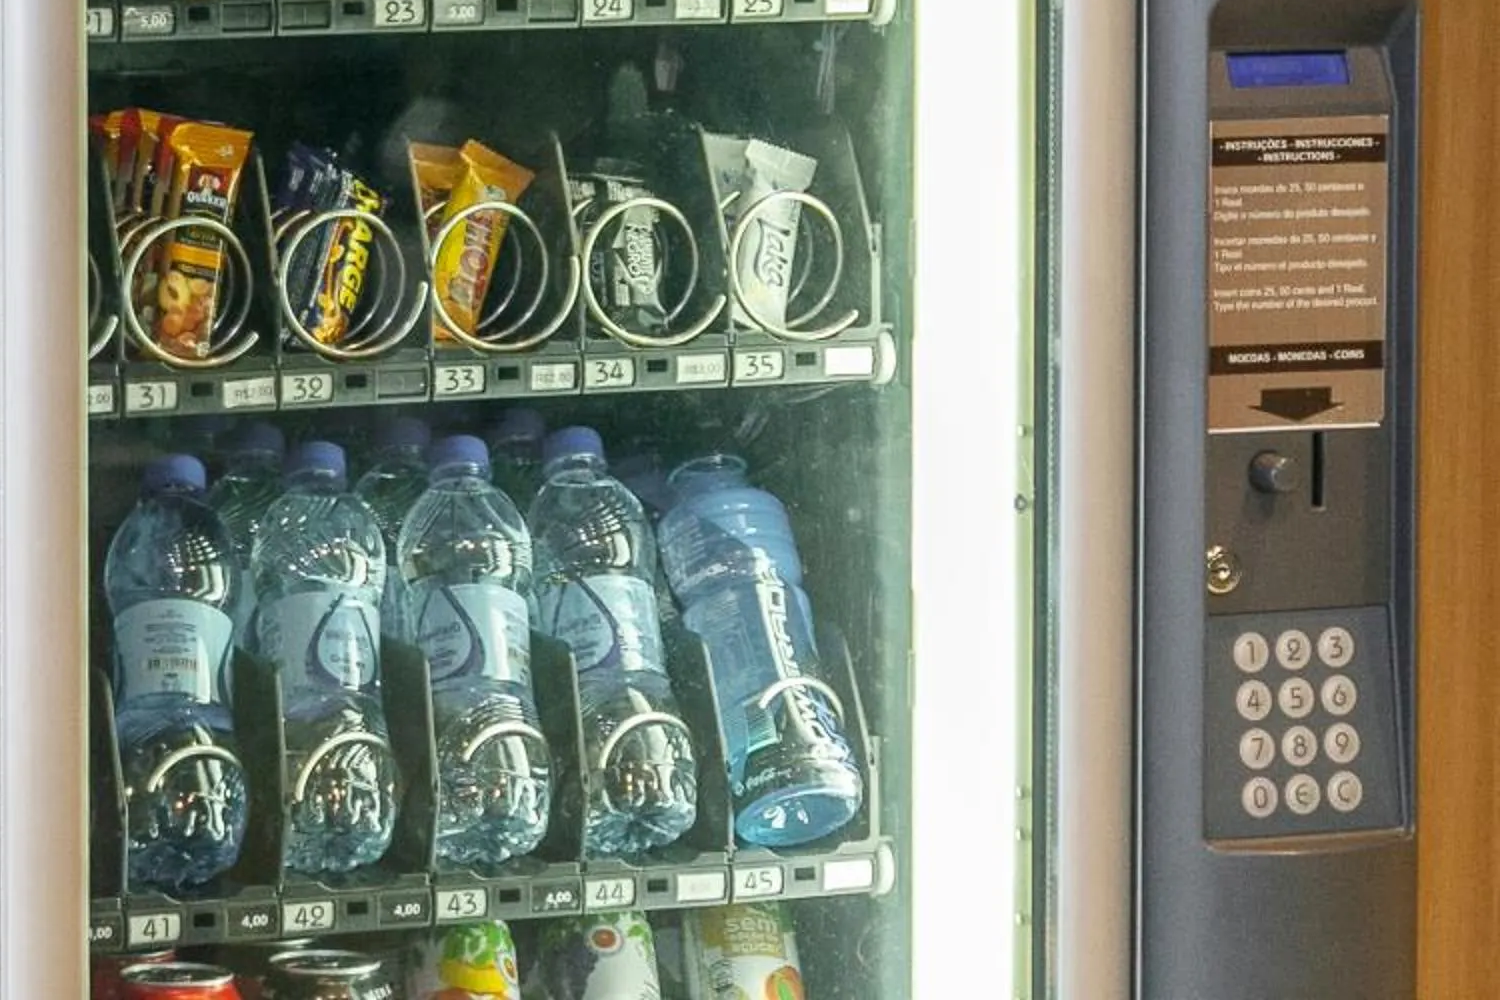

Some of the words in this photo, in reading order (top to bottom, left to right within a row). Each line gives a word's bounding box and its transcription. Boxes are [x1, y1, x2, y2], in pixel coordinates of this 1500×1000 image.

[384, 0, 415, 23] 23
[1294, 136, 1374, 149] INSTRUCCIONES
[1262, 151, 1336, 163] INSTRUCTIONS
[752, 216, 792, 290] Laka
[745, 355, 773, 377] 35
[1228, 353, 1271, 364] MOEDAS
[1277, 351, 1327, 362] MONEDAS
[1333, 349, 1365, 360] COINS
[444, 368, 475, 390] 33
[595, 359, 624, 383] 34
[139, 385, 167, 407] 31
[293, 377, 323, 399] 32
[1246, 640, 1255, 664] 1
[1286, 638, 1301, 661] 2
[1329, 635, 1343, 659] 3
[1247, 688, 1262, 712] 4
[1289, 686, 1304, 709] 5
[1332, 683, 1347, 707] 6
[1251, 737, 1264, 760] 7
[1293, 734, 1308, 758] 8
[1335, 731, 1350, 755] 9
[1253, 785, 1268, 809] 0
[1337, 779, 1351, 803] C
[744, 869, 773, 890] 45
[446, 892, 478, 915] 43
[595, 881, 625, 905] 44
[294, 904, 325, 928] 42
[393, 902, 421, 917] 4,00
[142, 916, 171, 939] 41
[240, 914, 269, 929] 4,00
[725, 916, 779, 933] sem
